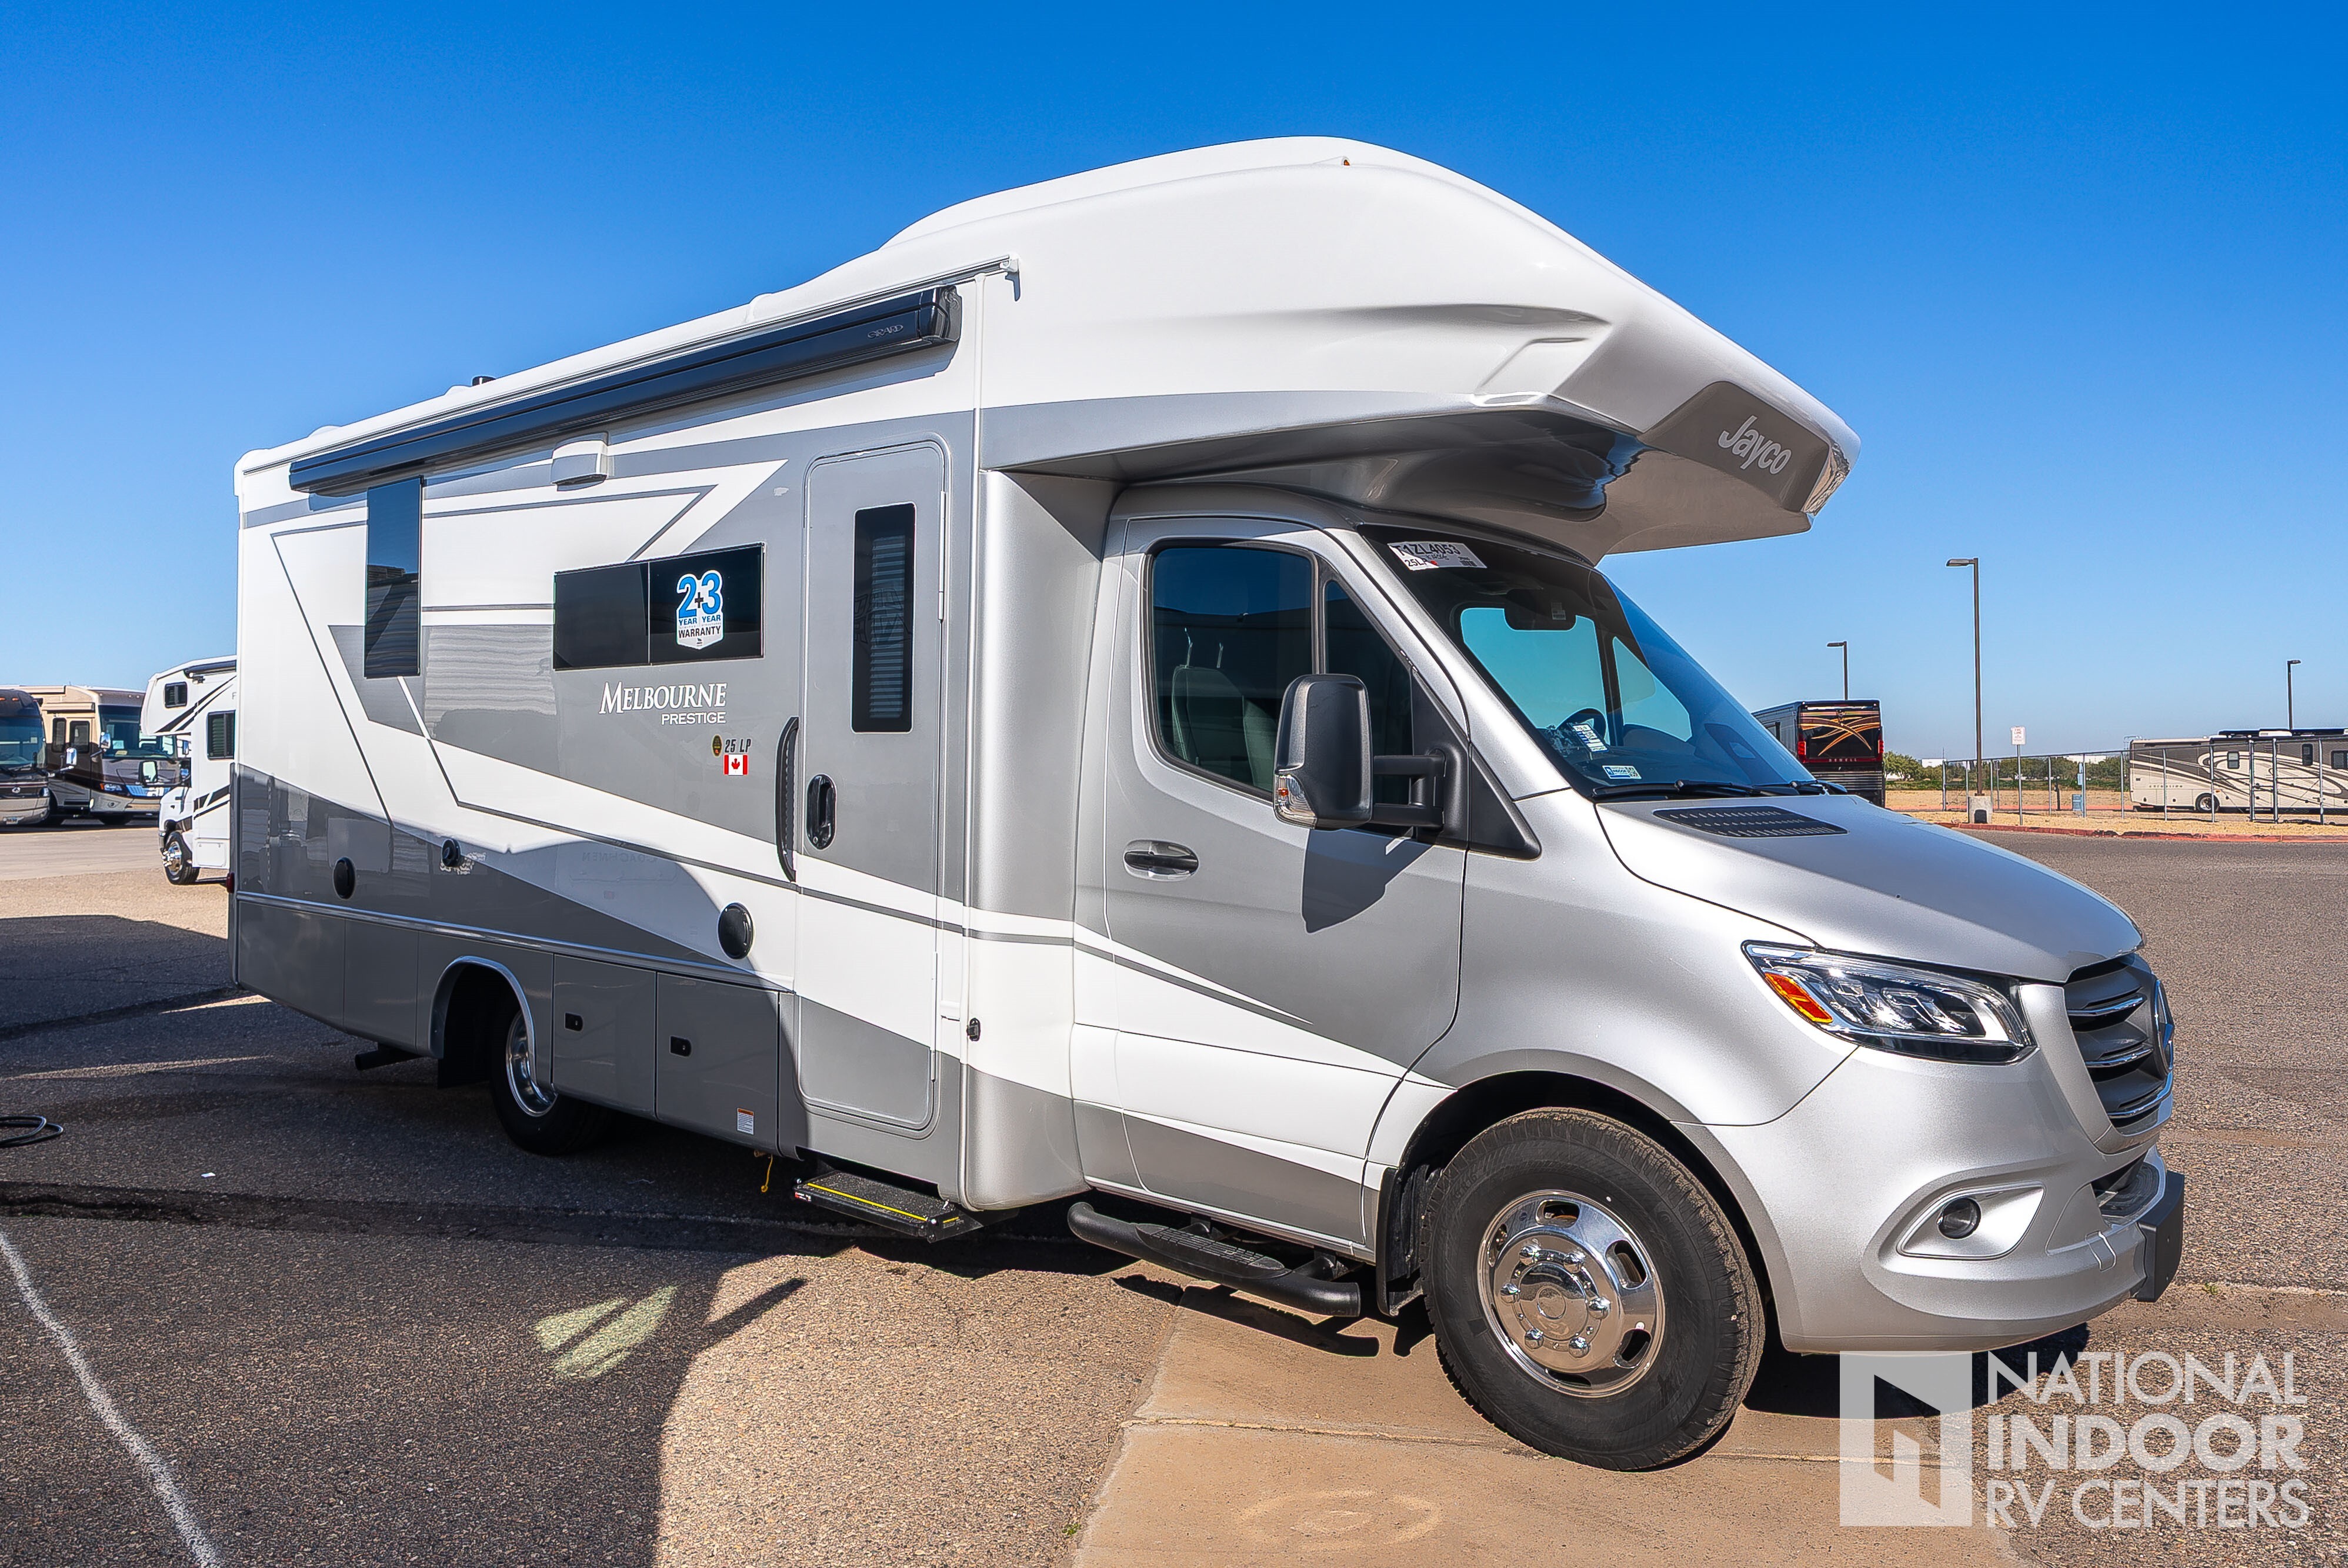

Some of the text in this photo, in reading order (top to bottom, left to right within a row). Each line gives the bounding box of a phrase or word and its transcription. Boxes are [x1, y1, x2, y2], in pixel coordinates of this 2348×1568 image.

[1718, 415, 1792, 475] Jayco
[679, 618, 698, 626] YEAR
[702, 615, 721, 623] YEAR
[679, 626, 721, 638] WARRANTY
[599, 682, 727, 714] MELBOURNE
[661, 712, 726, 725] PRESTIGE
[724, 739, 736, 753] 25
[739, 738, 752, 753] LP
